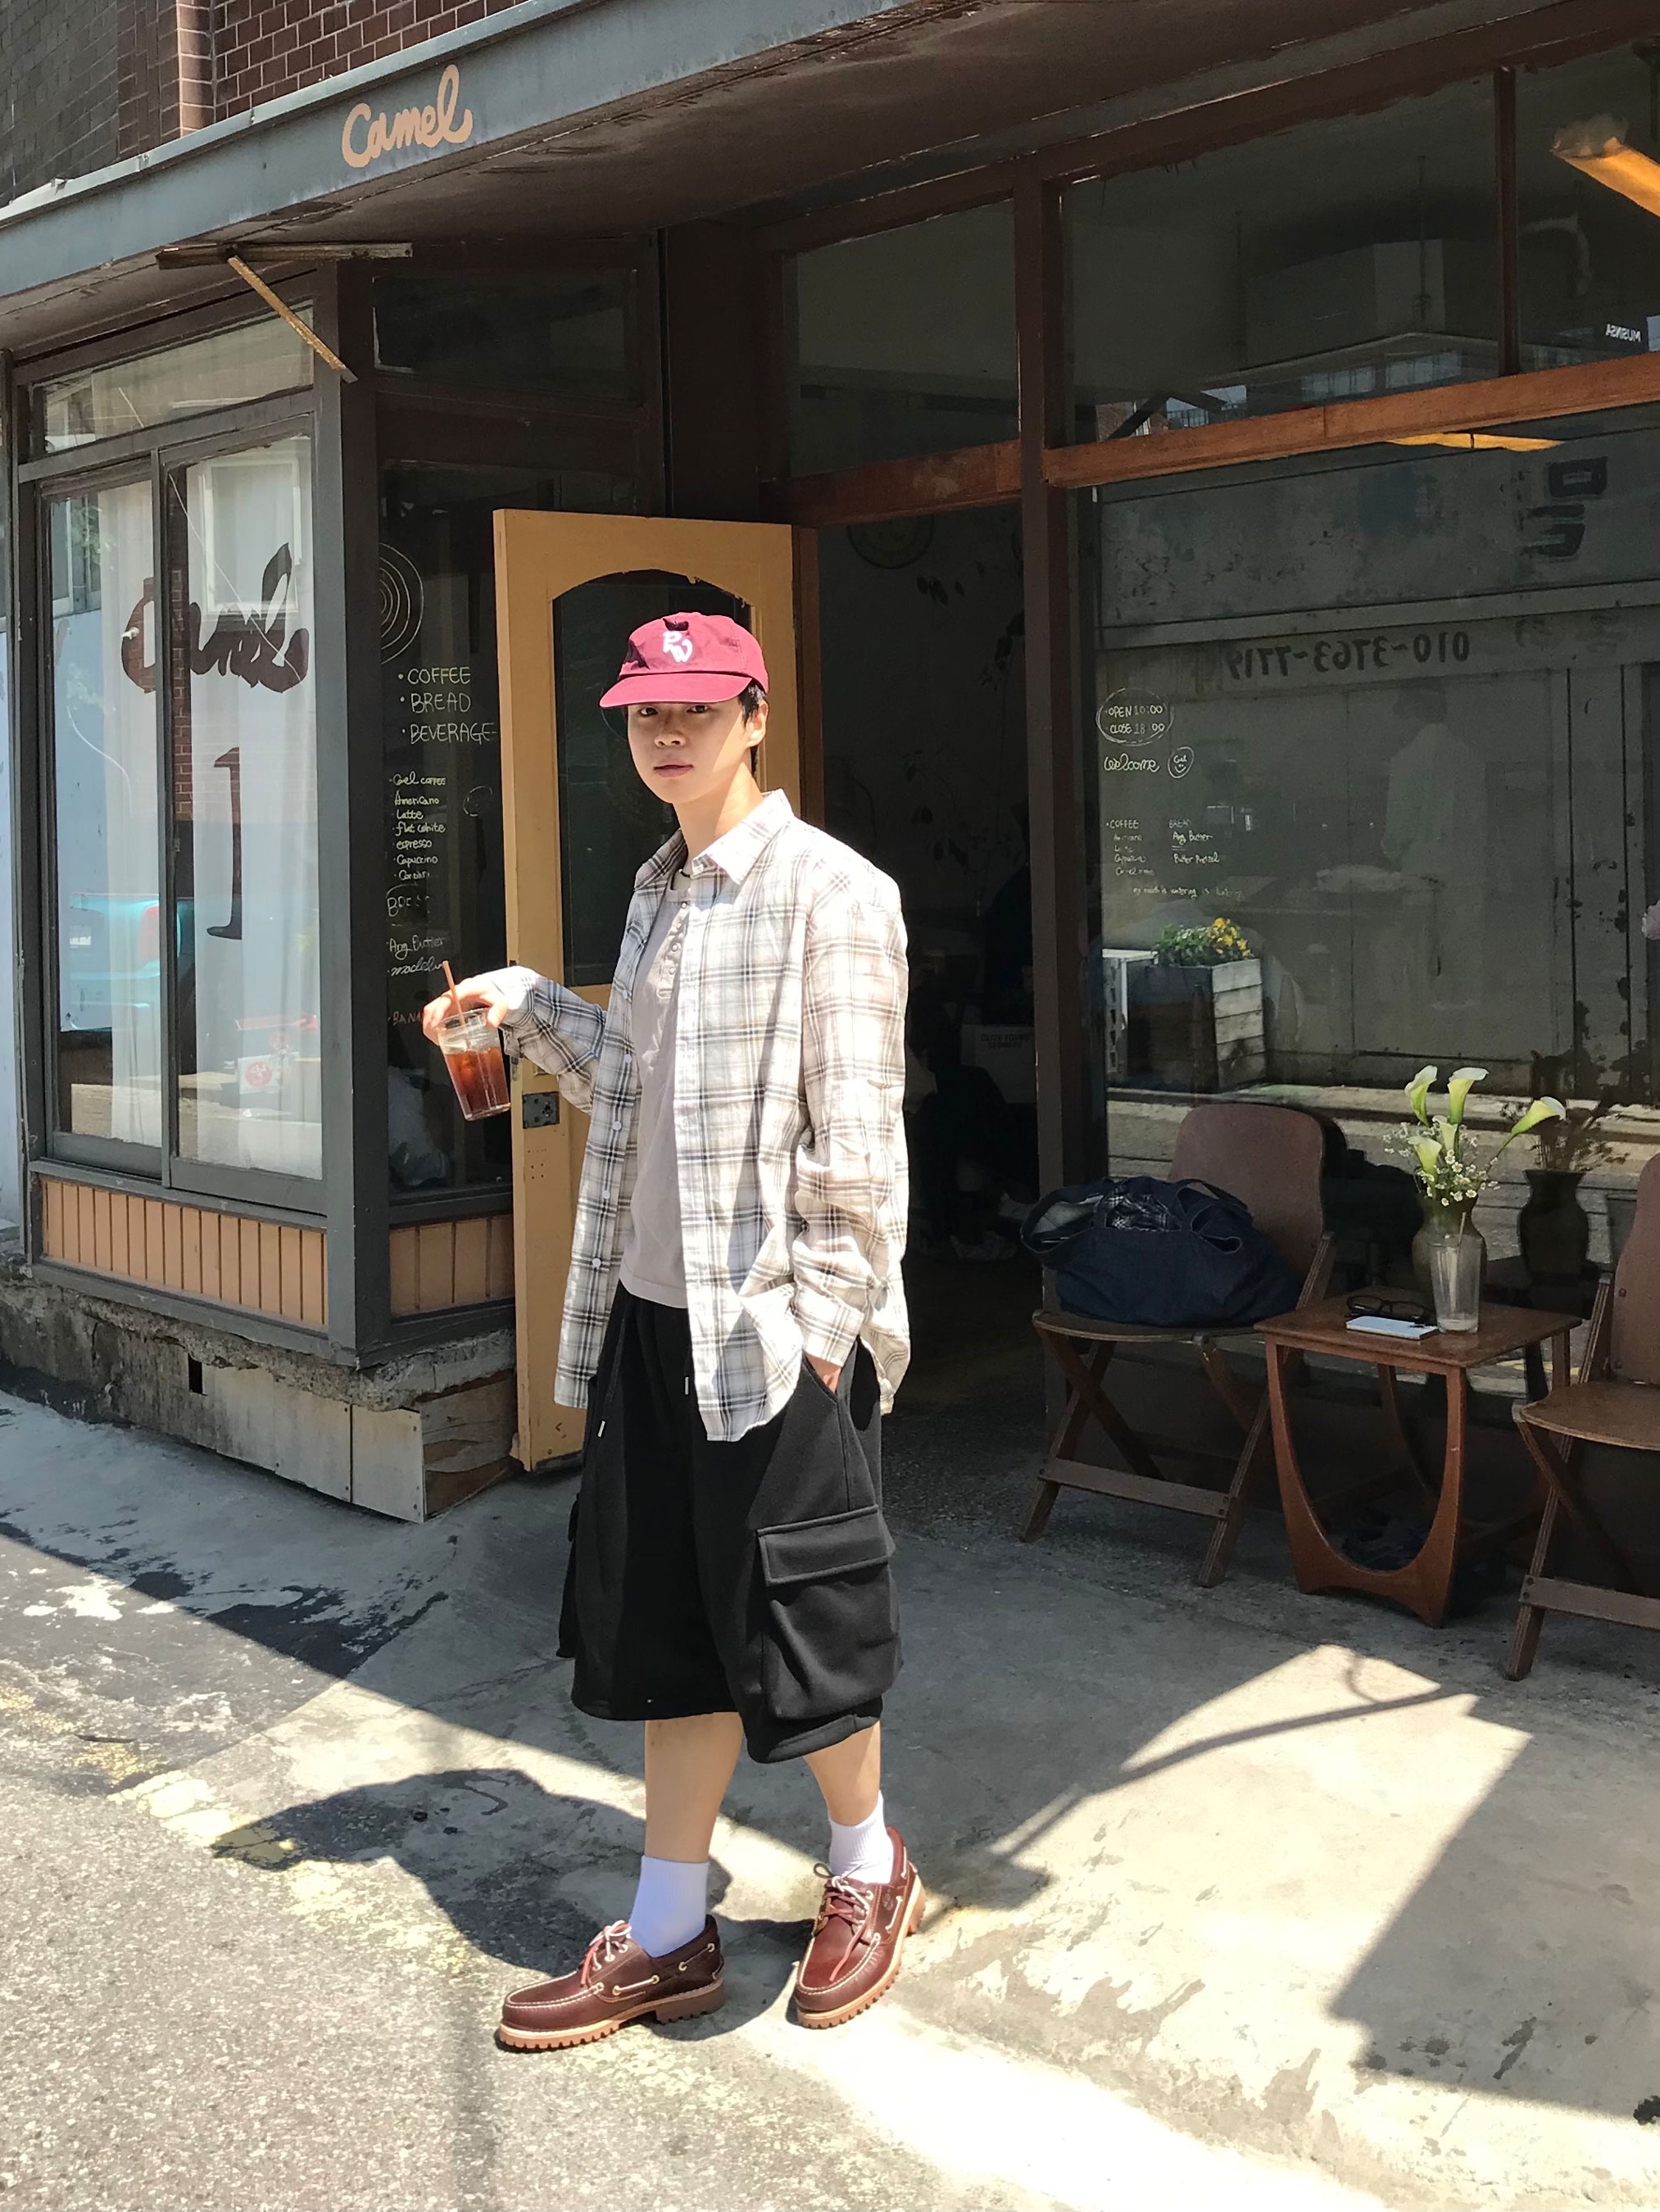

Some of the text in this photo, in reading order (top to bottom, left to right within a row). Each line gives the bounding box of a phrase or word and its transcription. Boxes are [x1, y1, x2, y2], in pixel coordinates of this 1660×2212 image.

[342, 64, 473, 168] Camel
[407, 666, 472, 685] COFFEE
[410, 692, 472, 714] BREAD
[1108, 705, 1132, 718] OPEN
[410, 722, 498, 746] BEVERAGE
[1109, 723, 1132, 734] CLOSE
[1109, 819, 1140, 830] COFFEE
